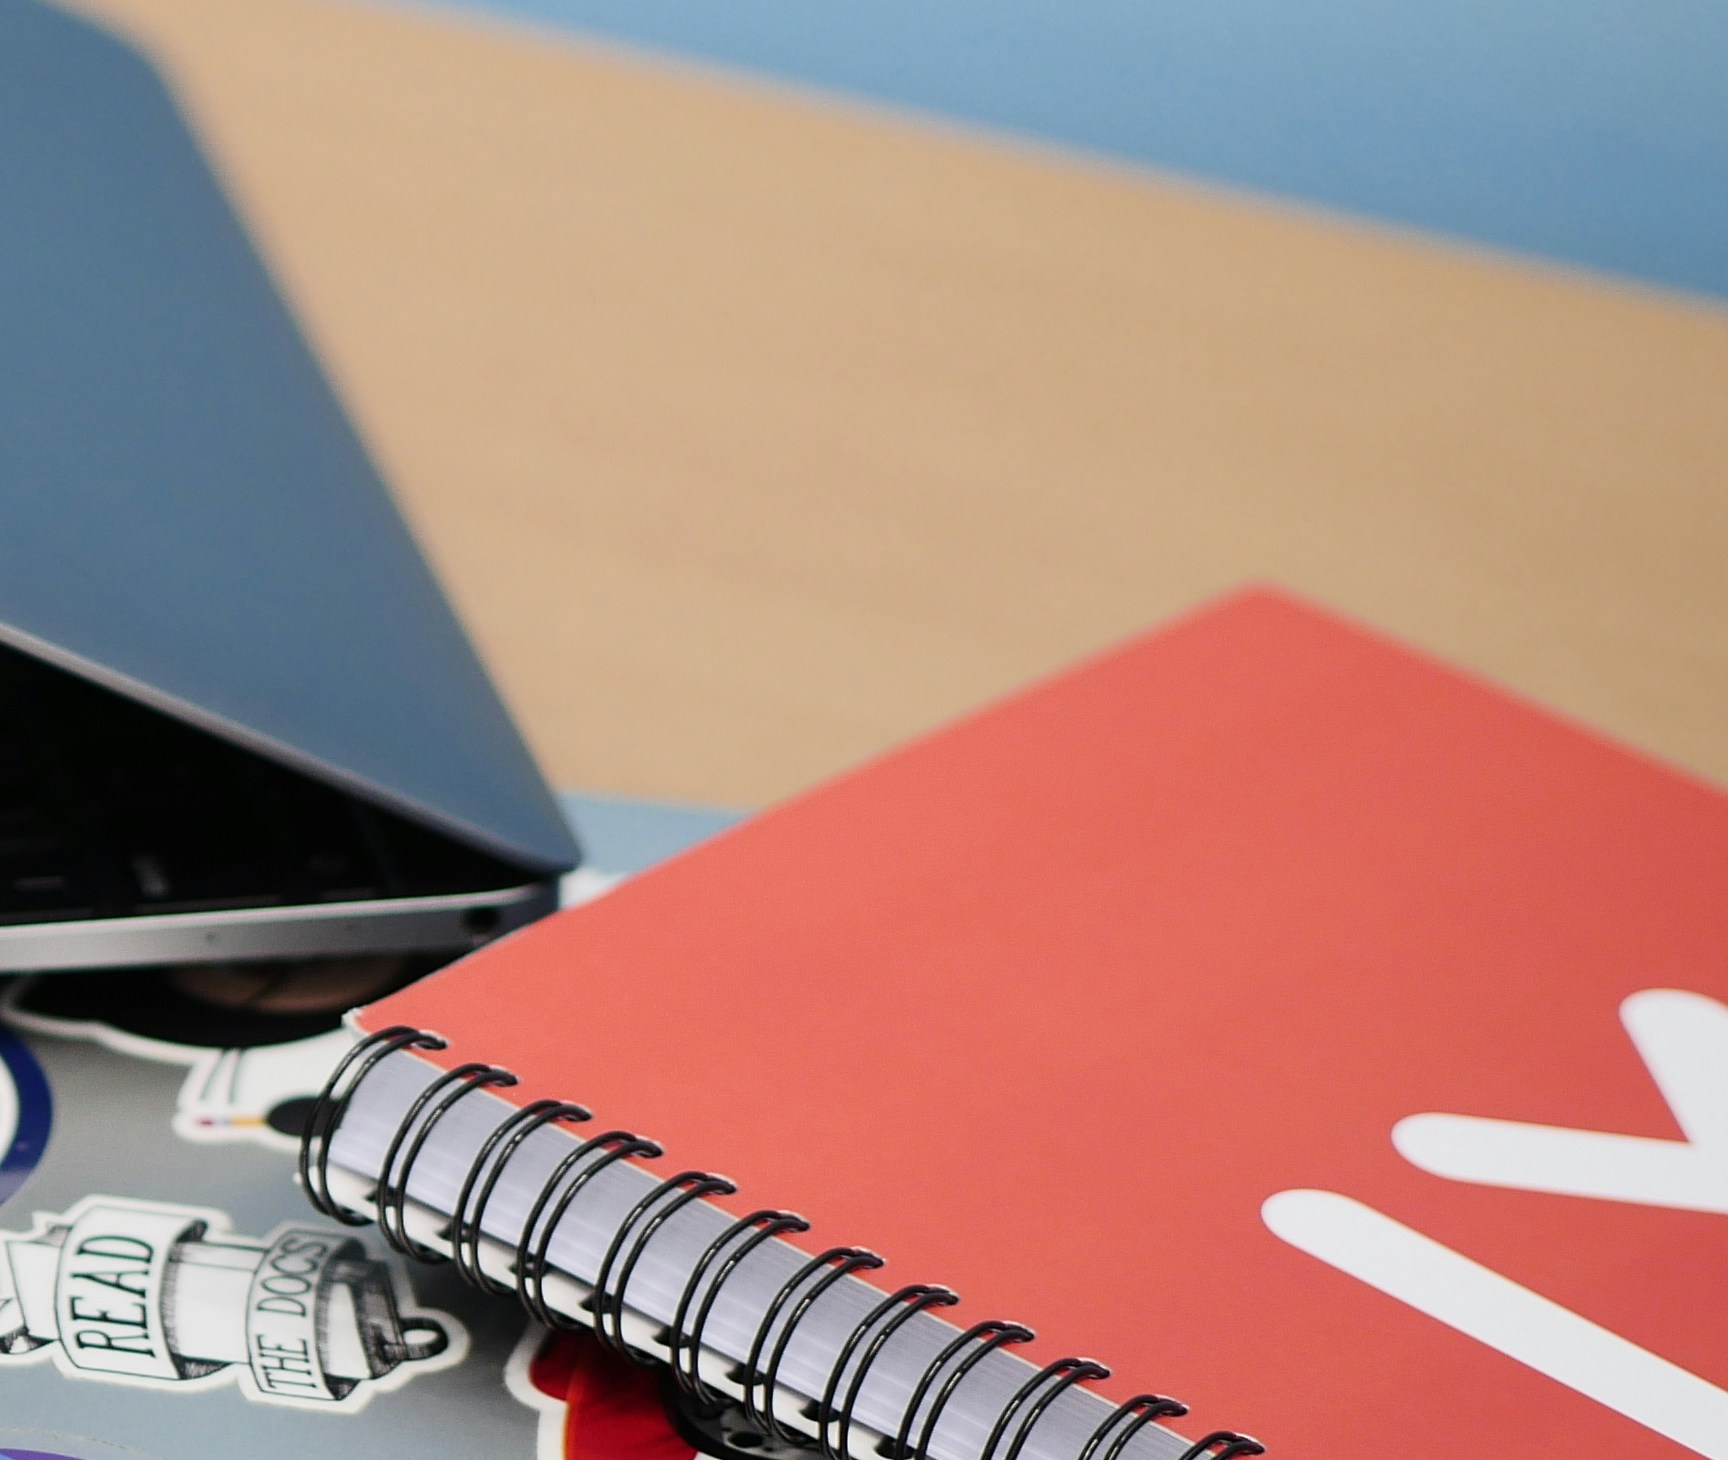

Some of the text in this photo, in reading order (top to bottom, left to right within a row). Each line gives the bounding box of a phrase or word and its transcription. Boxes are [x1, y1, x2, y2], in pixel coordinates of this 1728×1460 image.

[68, 1234, 156, 1358] READ
[255, 1238, 328, 1388] THE DOCS
